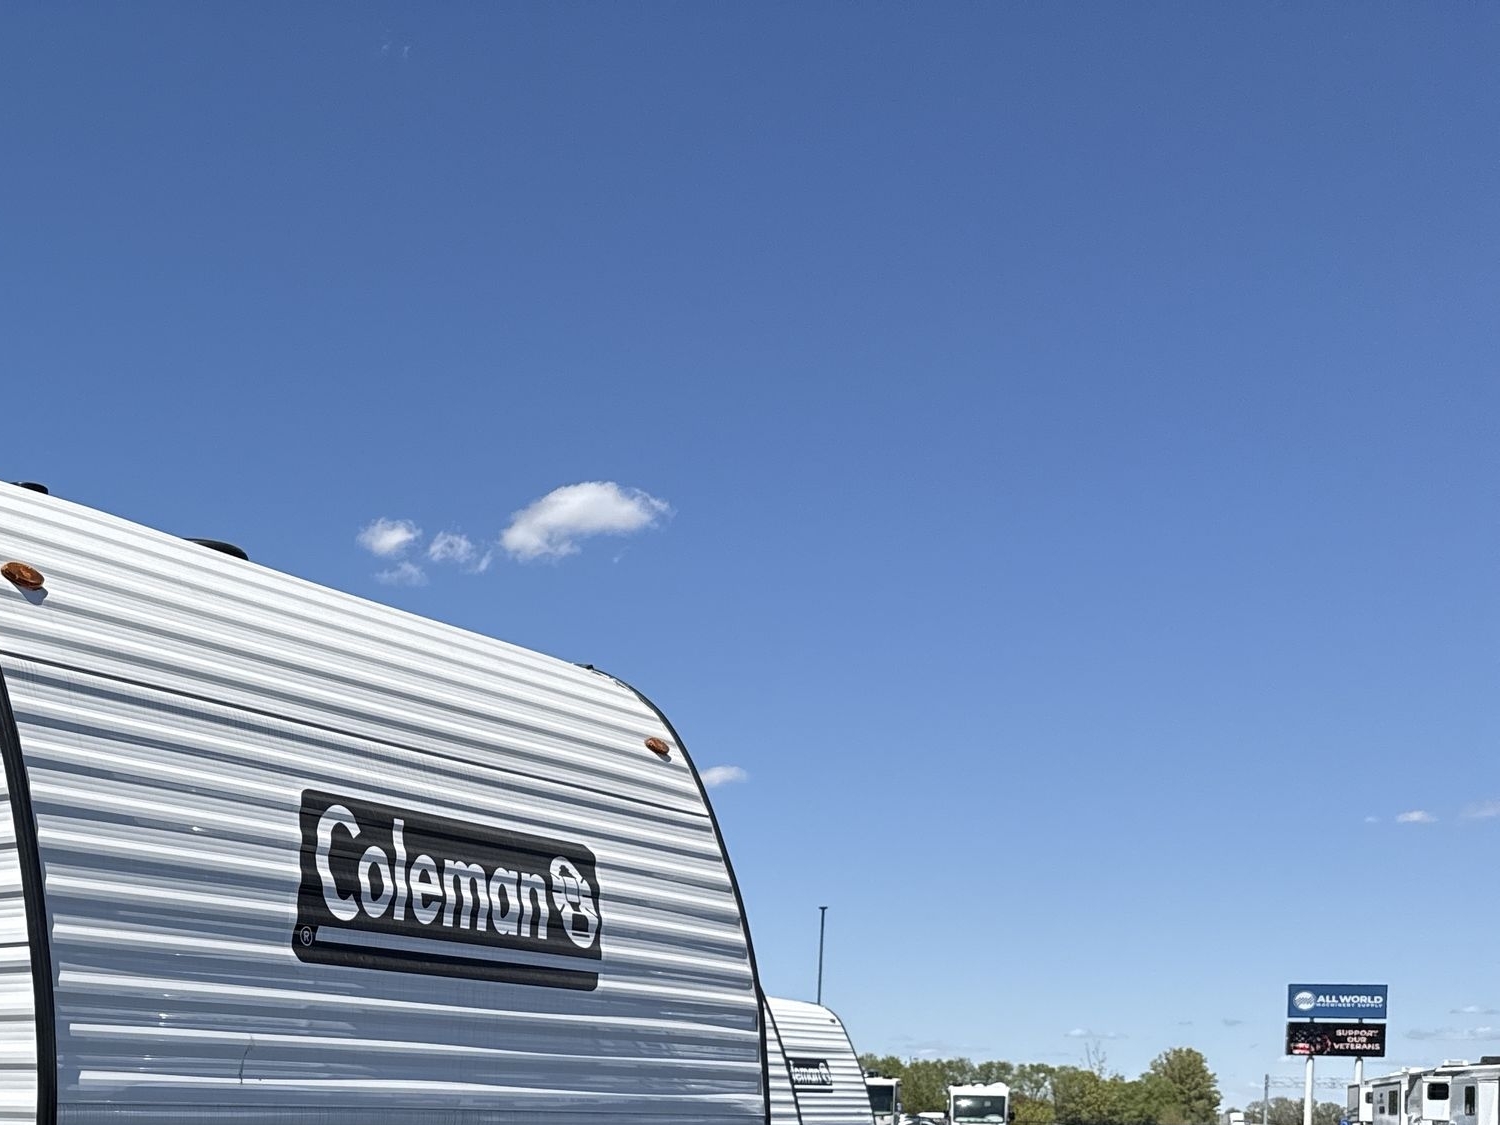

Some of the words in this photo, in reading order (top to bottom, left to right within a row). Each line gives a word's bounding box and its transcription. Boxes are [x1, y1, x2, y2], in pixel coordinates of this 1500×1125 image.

[315, 804, 549, 940] Coleman
[1317, 995, 1338, 1003] ALL
[1339, 995, 1384, 1004] WORLD
[1336, 1029, 1379, 1037] SUPPORT
[1333, 1043, 1381, 1051] VETERANS
